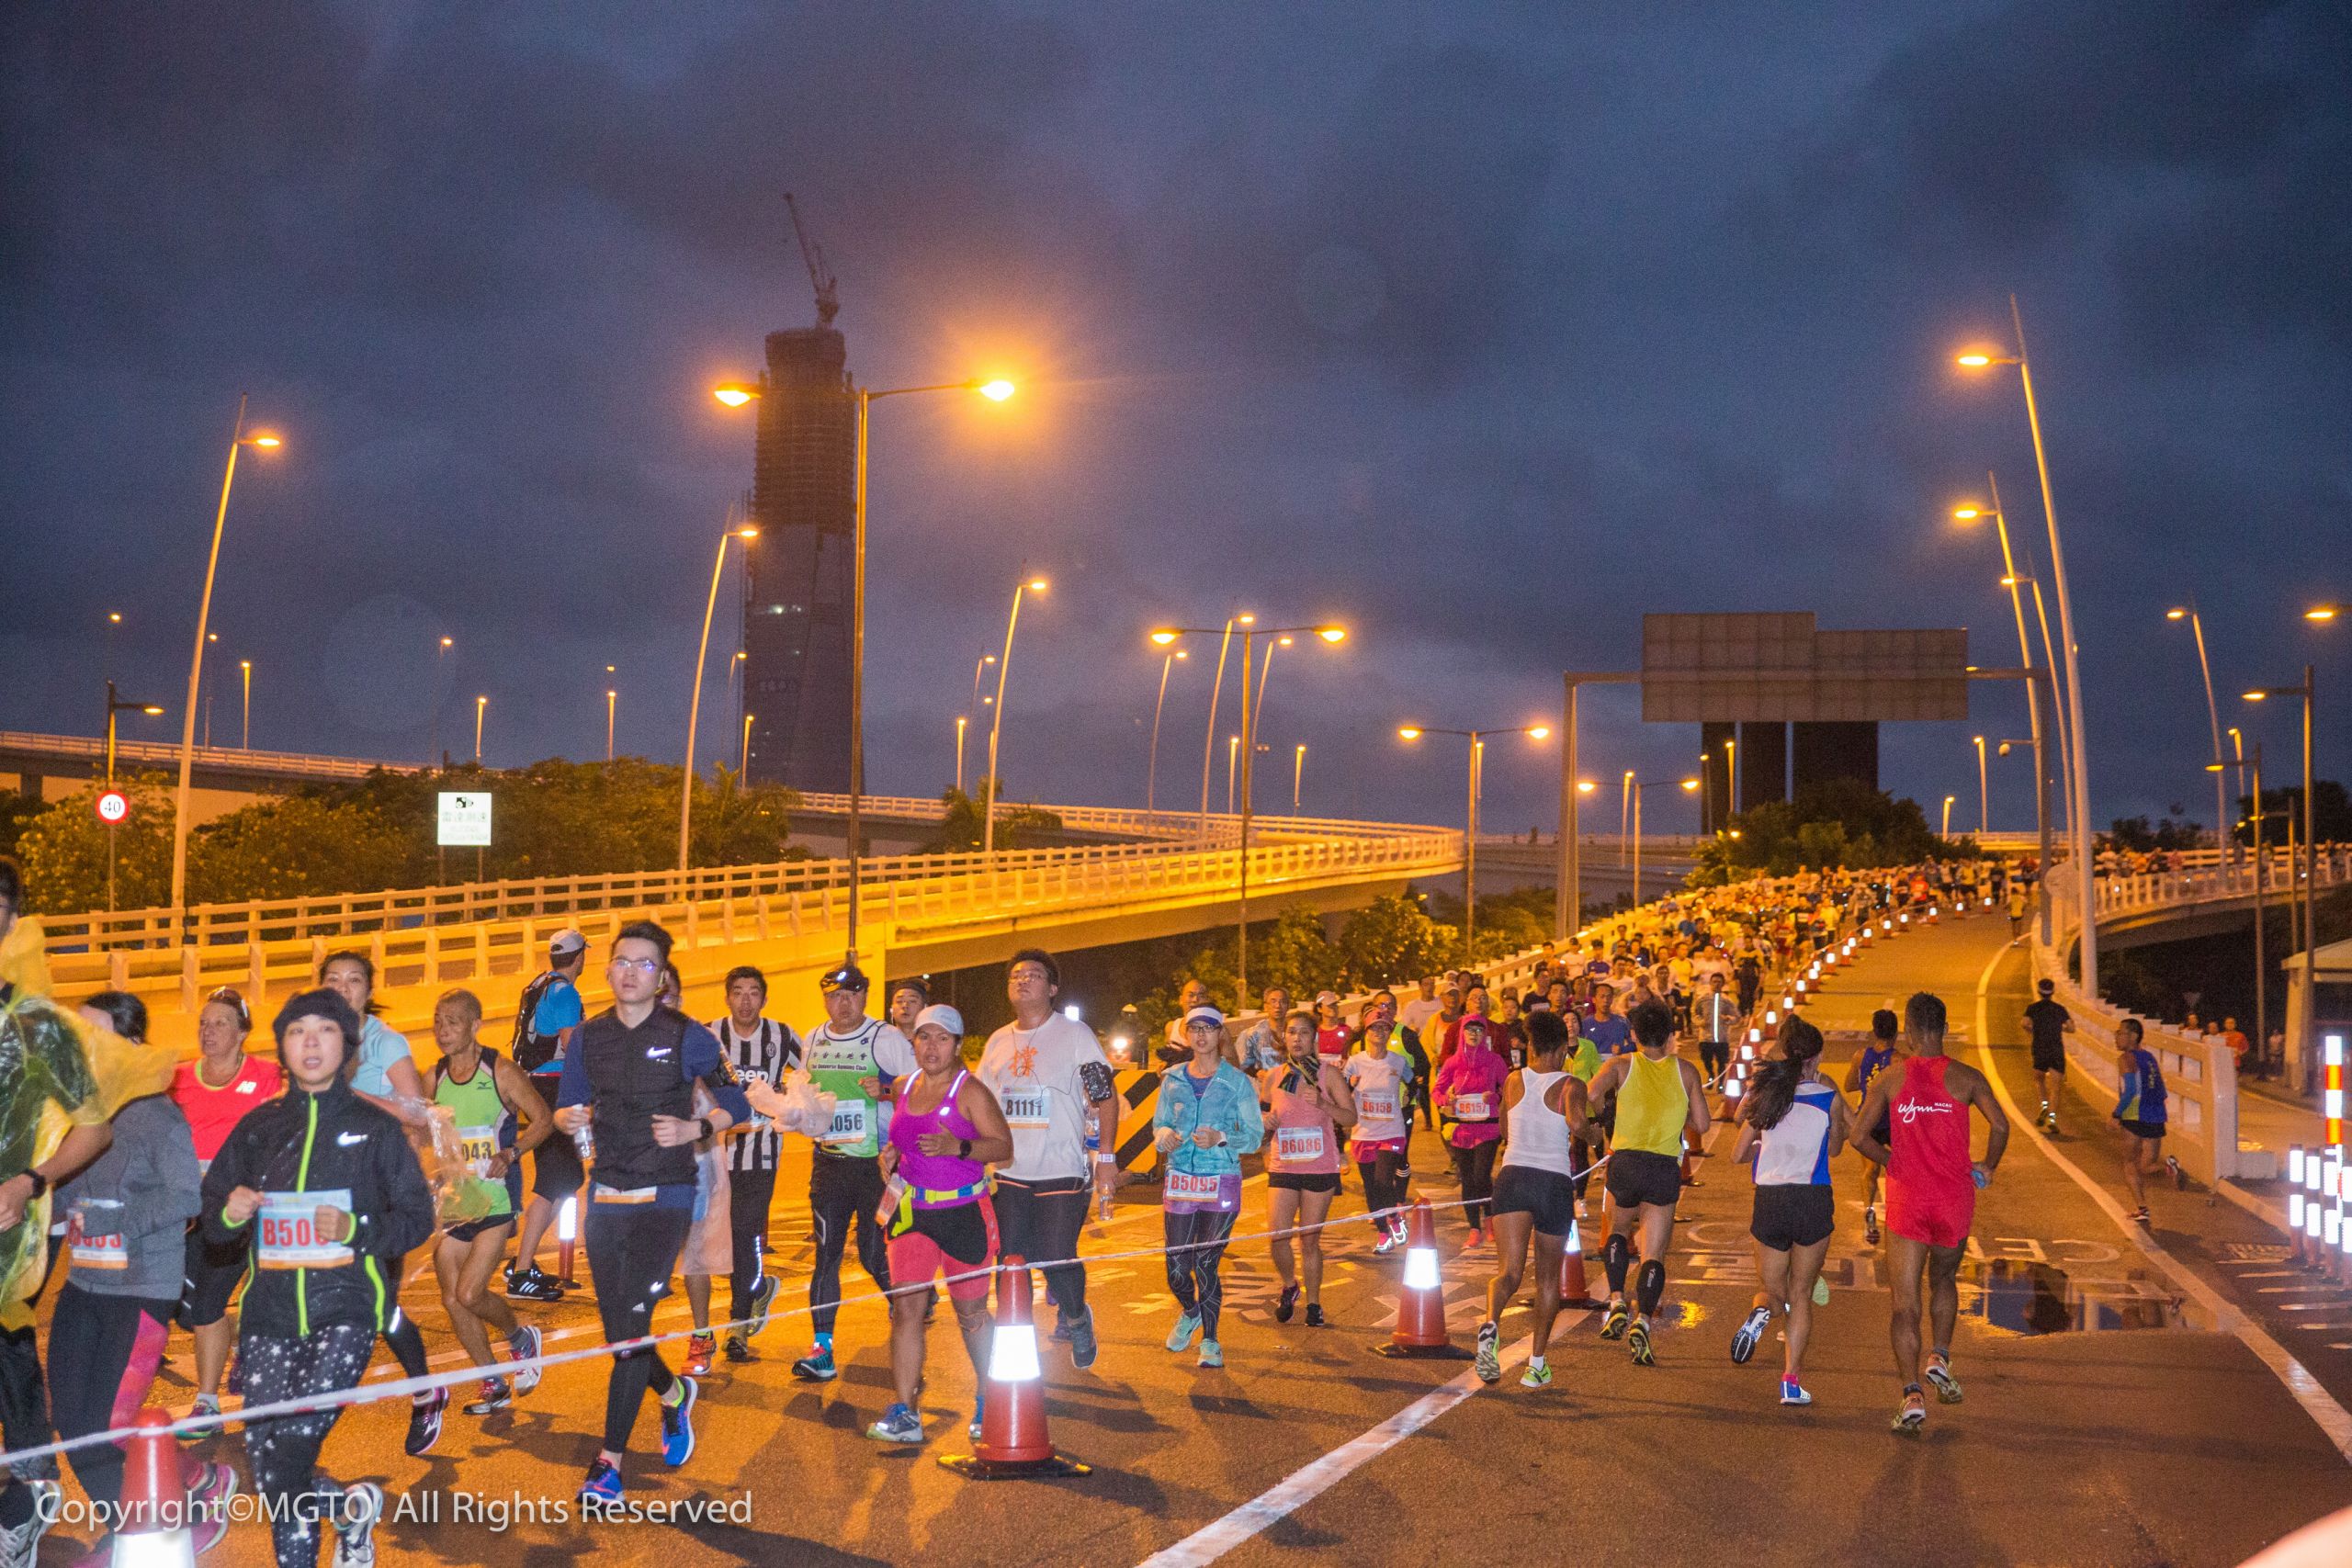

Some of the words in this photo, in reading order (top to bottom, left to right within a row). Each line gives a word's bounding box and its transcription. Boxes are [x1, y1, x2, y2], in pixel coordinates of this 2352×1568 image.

[103, 801, 121, 813] 40
[1170, 1175, 1217, 1192] B5095
[262, 1217, 329, 1247] B50
